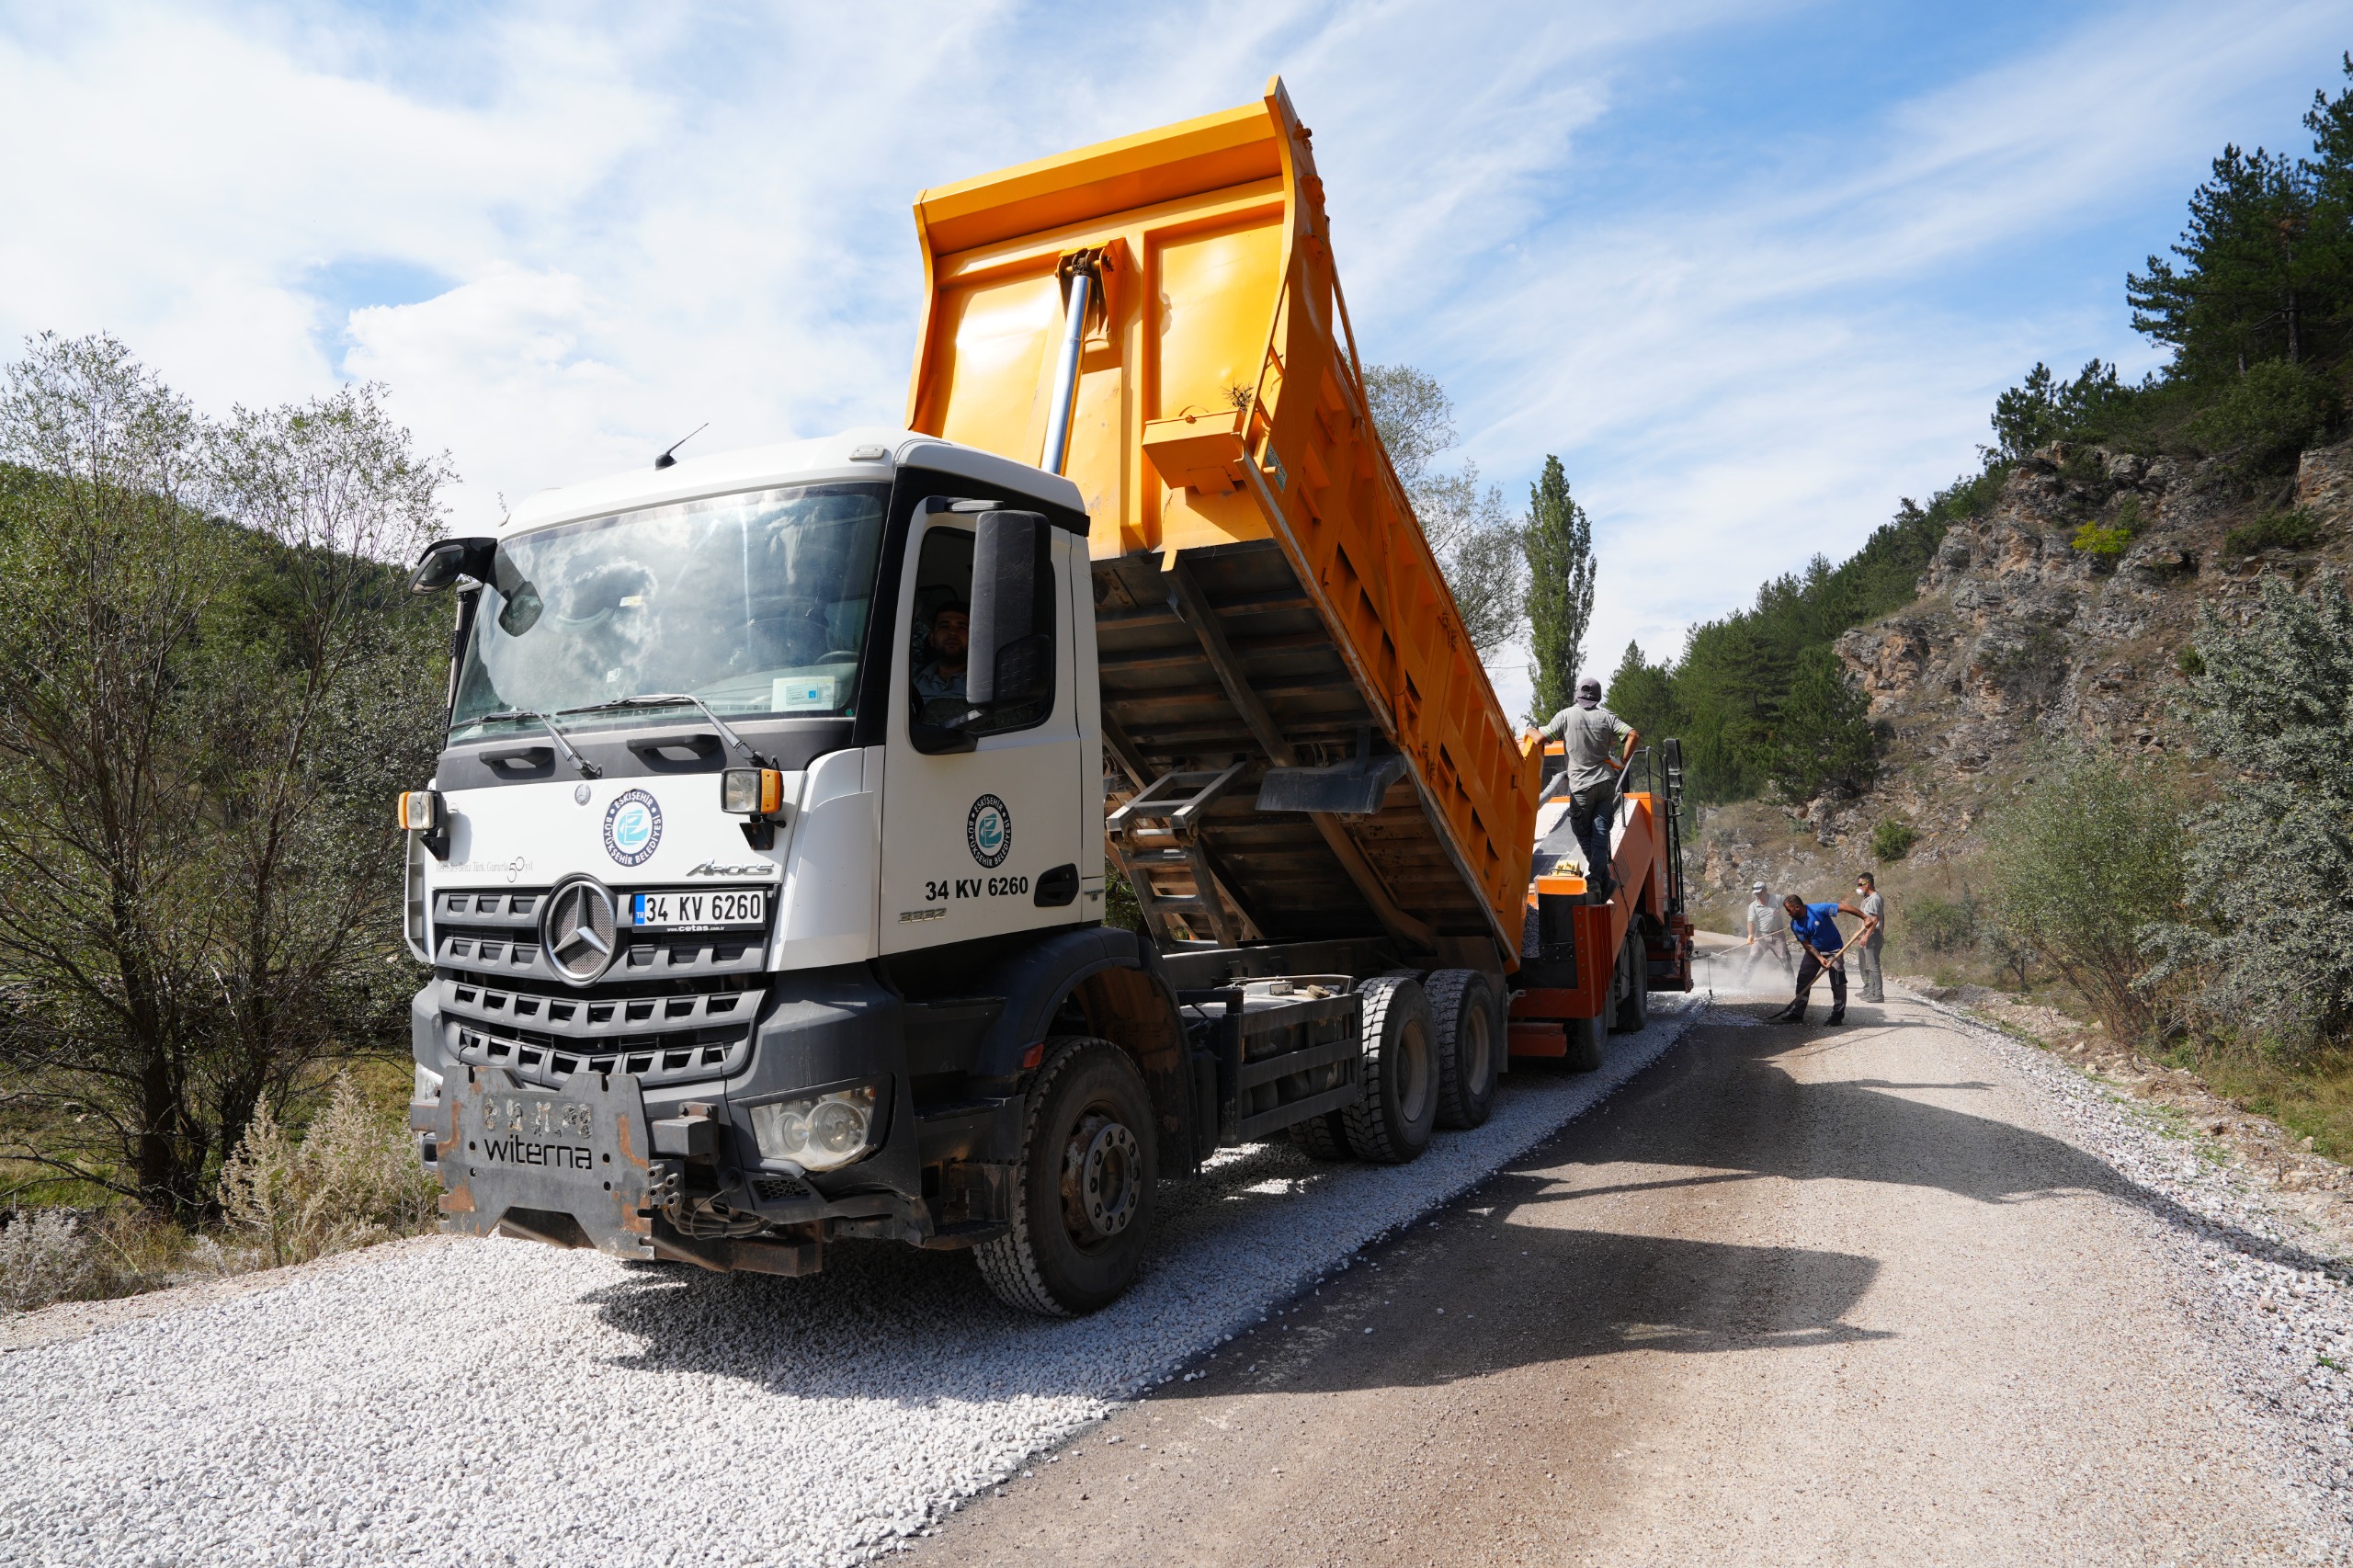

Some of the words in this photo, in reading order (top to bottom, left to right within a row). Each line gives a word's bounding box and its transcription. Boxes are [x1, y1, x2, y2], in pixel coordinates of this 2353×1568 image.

[614, 791, 654, 809] ESKİŞEHİR
[974, 796, 1004, 812] ESKİŞEHİR
[604, 816, 633, 865] BÜYÜKŞEHİR
[634, 814, 662, 864] BELEDİYESİ
[968, 820, 994, 867] BÜYÜKŞEHİR
[994, 819, 1011, 865] BELEDİYESİ
[506, 856, 525, 883] 50
[926, 881, 949, 901] 34
[956, 879, 983, 899] KV
[988, 876, 1029, 897] 6260
[636, 911, 645, 919] TR
[646, 897, 668, 923] 34
[679, 895, 703, 921] KV
[711, 893, 761, 920] 6260
[483, 1133, 593, 1170] witerna
